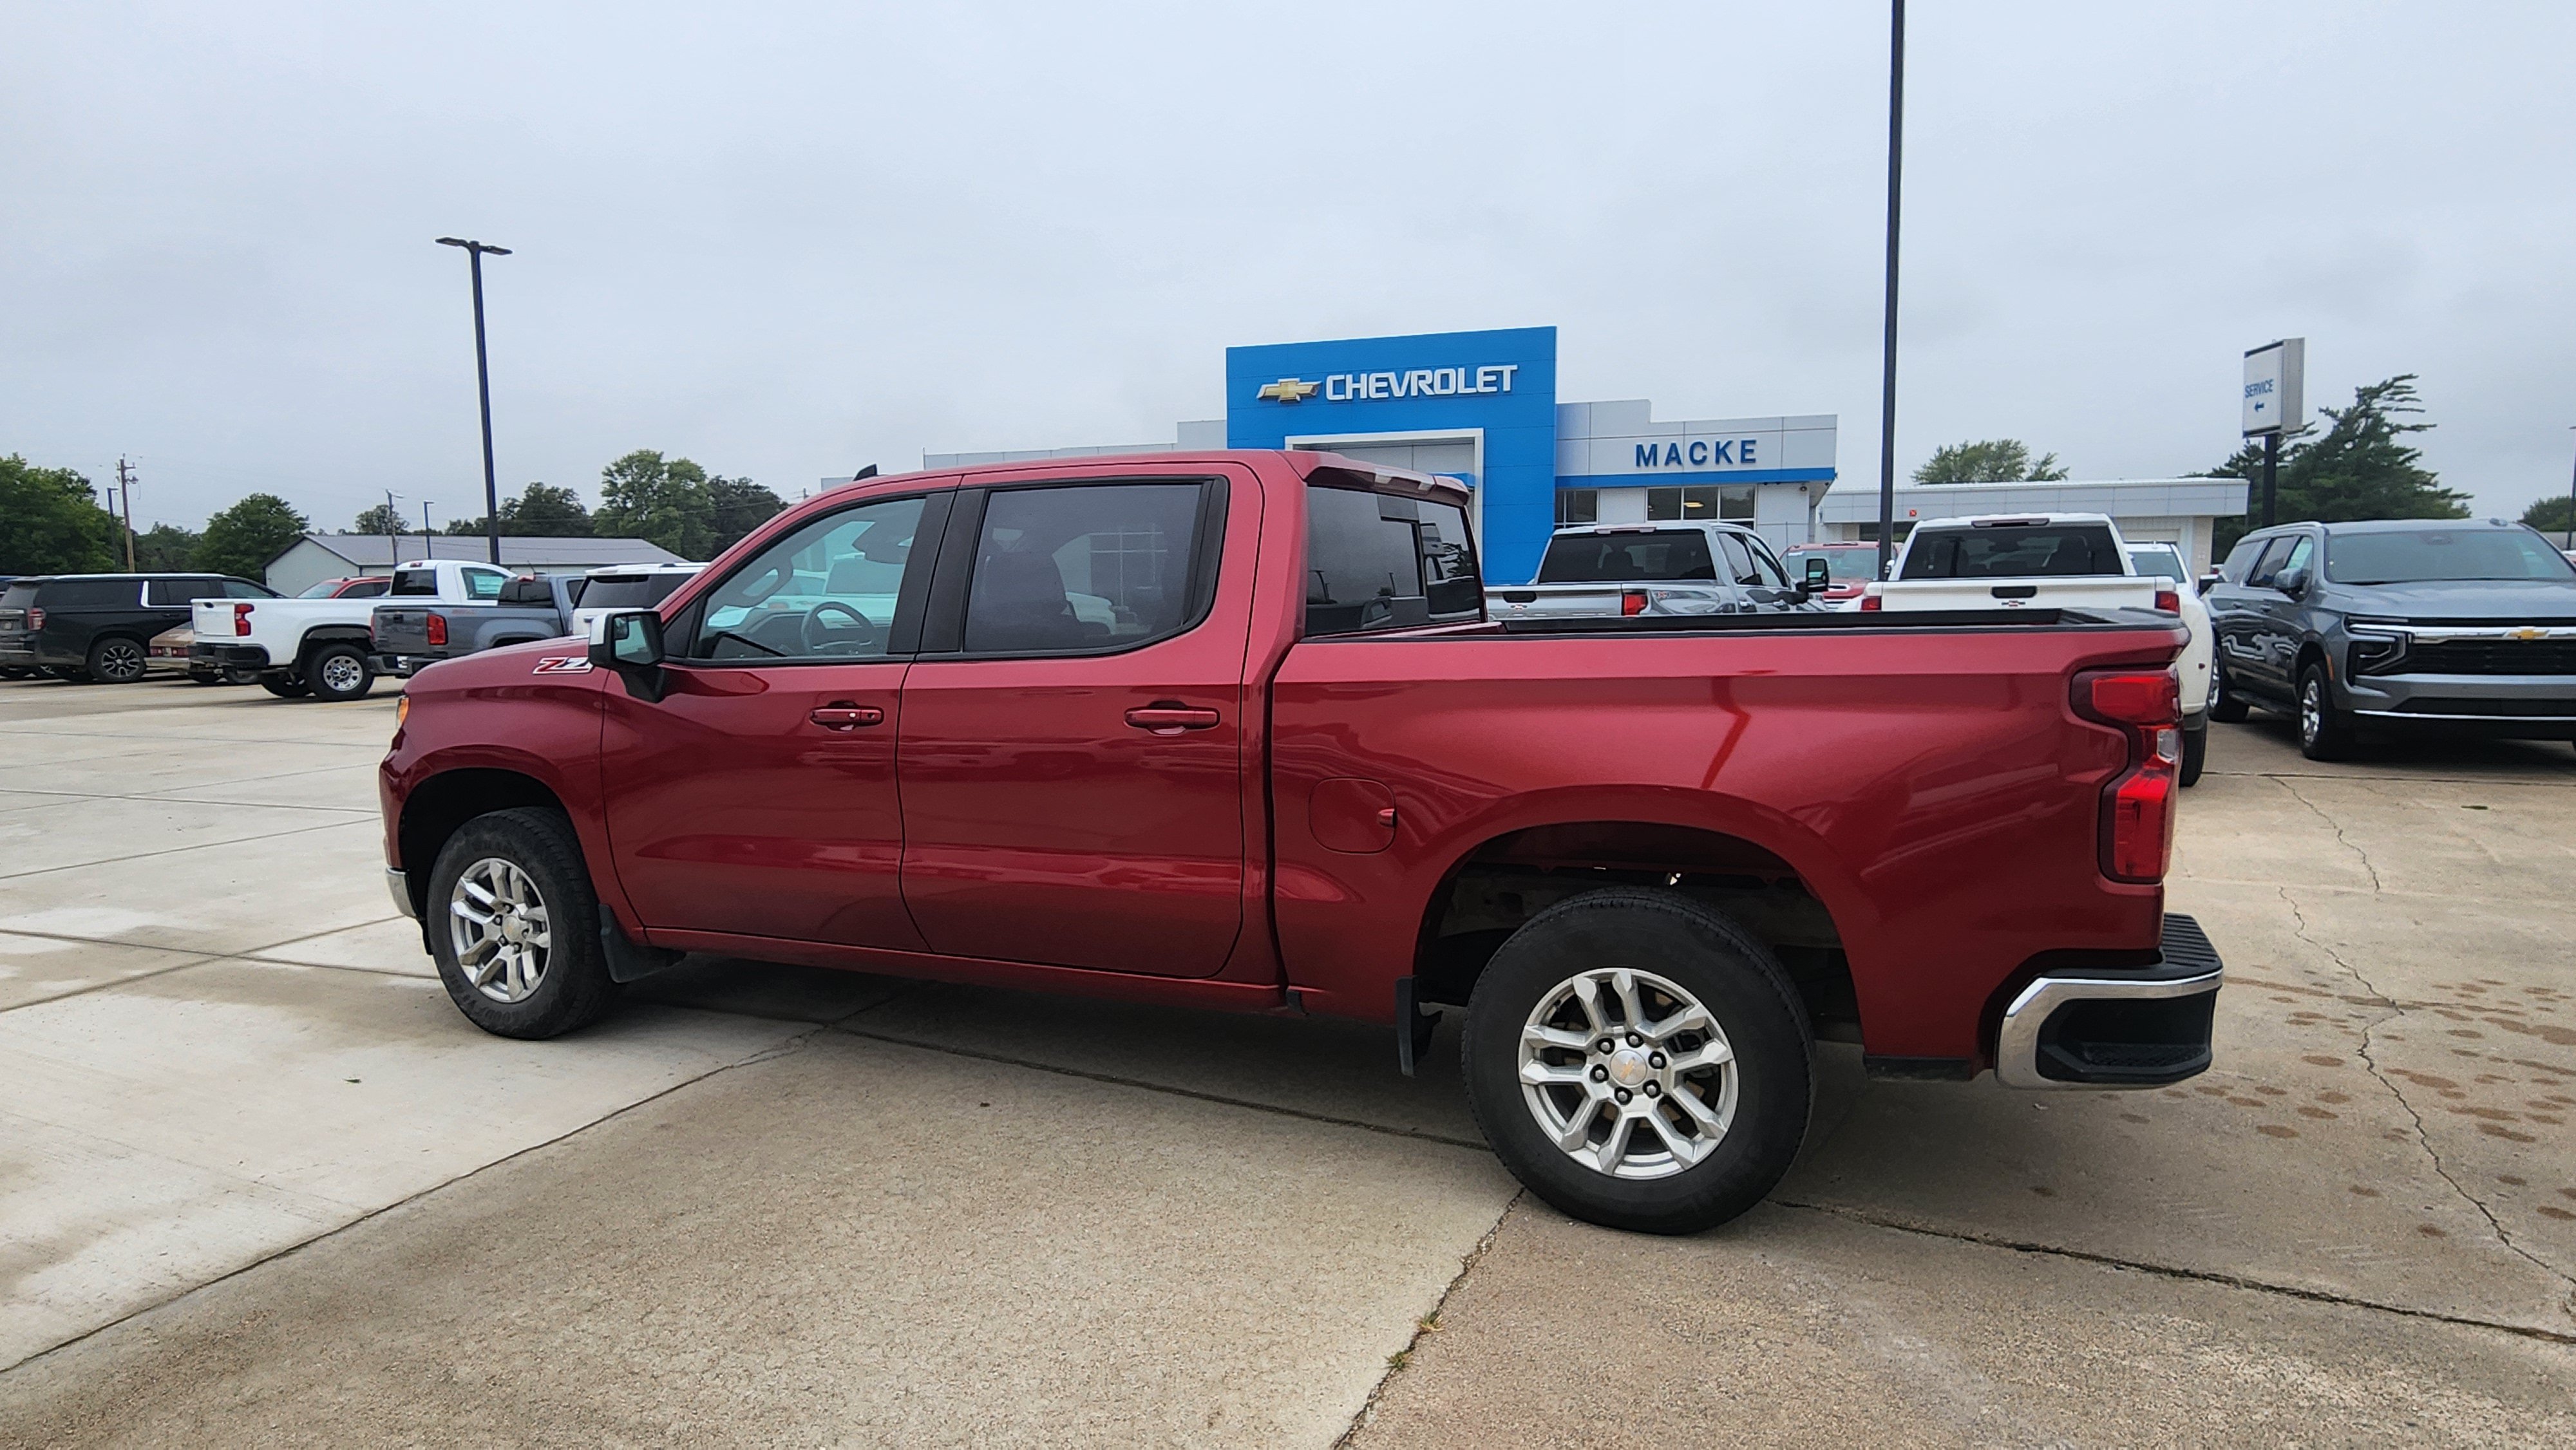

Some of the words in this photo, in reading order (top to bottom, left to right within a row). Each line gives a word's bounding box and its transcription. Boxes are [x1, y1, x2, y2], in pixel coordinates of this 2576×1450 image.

[1325, 364, 1518, 401] CHEVROLET
[2244, 379, 2274, 399] SERVICE
[1635, 440, 1757, 467] MACKE
